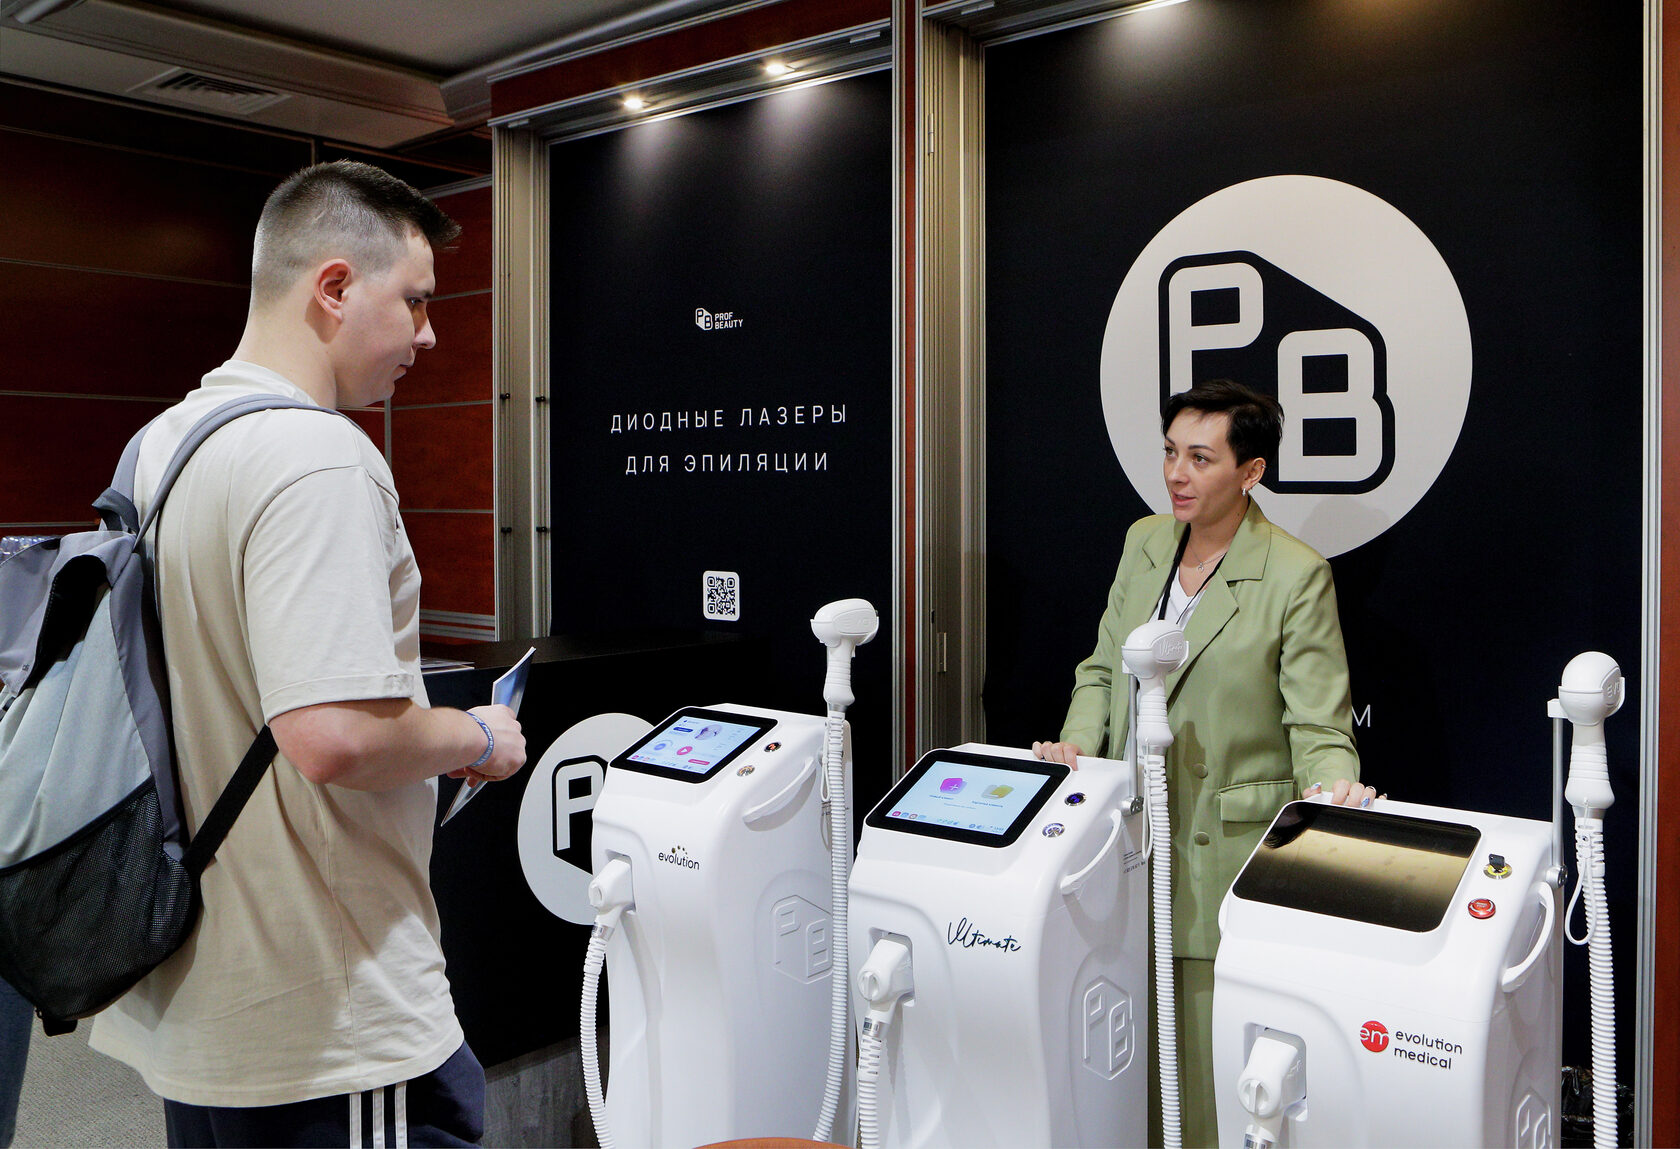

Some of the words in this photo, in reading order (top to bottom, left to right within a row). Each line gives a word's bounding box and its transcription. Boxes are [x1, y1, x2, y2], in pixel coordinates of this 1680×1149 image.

[714, 312, 733, 321] PROF
[714, 319, 743, 329] BEAUTY
[611, 410, 723, 433] ДИОДНЫЕ
[740, 405, 845, 426] ЛАЗЕРЫ
[626, 456, 668, 474] ДЛЯ
[684, 453, 827, 472] ЭПИЛЯЦИИ
[658, 852, 699, 870] evolution
[947, 917, 1021, 952] Ultimate
[1395, 1030, 1462, 1055] evolution
[1394, 1047, 1452, 1070] medical
